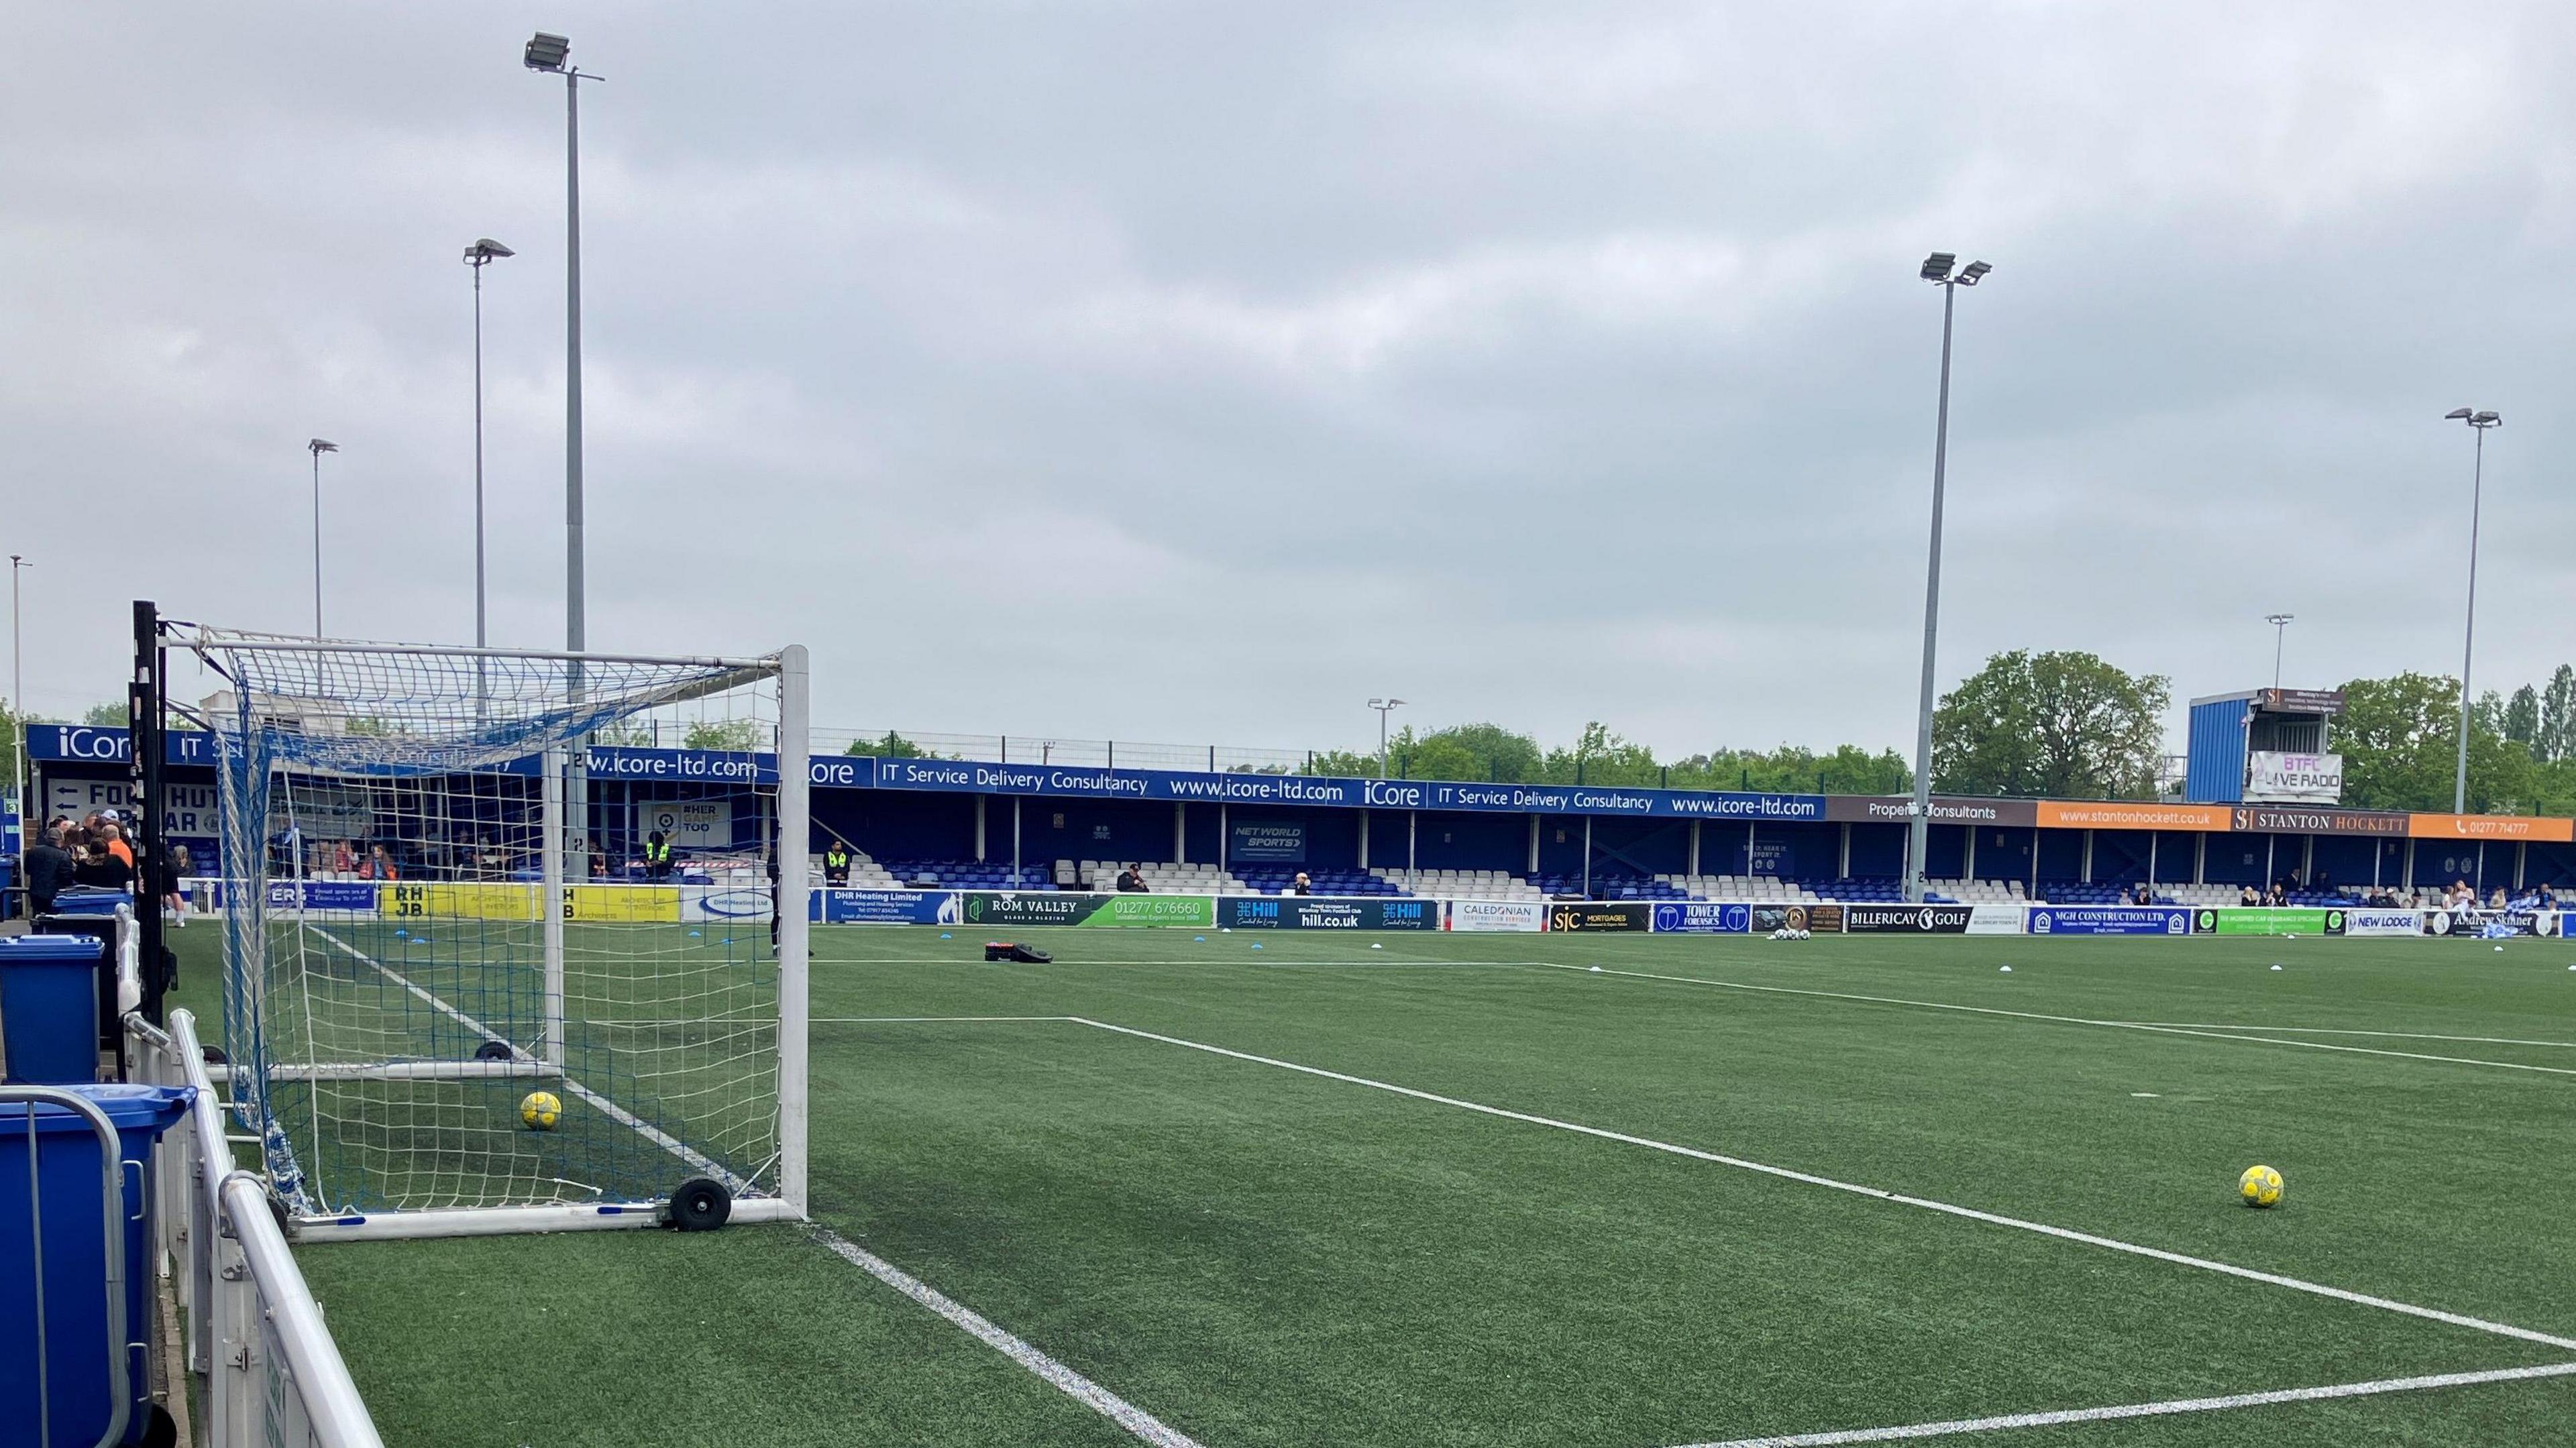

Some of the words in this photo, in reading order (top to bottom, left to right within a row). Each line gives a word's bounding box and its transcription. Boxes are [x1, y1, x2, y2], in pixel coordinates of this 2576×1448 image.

[59, 726, 131, 758] iCor
[181, 738, 201, 757] IT
[574, 753, 582, 767] 2
[588, 754, 758, 777] w.icore-ltd.com
[2284, 757, 2320, 771] BTFC
[809, 763, 854, 785] ore
[2301, 774, 2340, 787] RADIO
[883, 764, 900, 781] IT
[907, 765, 968, 785] Service
[977, 769, 1044, 791] Delivery
[1051, 771, 1148, 795] Consultancy
[1170, 778, 1342, 801] www.icore-ltd.com
[90, 784, 132, 805] FO
[170, 787, 219, 809] HUT
[1364, 780, 1419, 805] iCore
[1439, 788, 1452, 803] IT
[1458, 789, 1507, 805] Service
[1513, 790, 1568, 809] Delivery
[1574, 792, 1653, 812] Consultancy
[1672, 796, 1815, 816] www.icore-ltd.com
[683, 805, 716, 815] #HER
[1869, 803, 1910, 819] Proper
[1929, 805, 1996, 820] onsultants
[1923, 806, 1929, 817] 2
[164, 812, 197, 832] AR
[2059, 810, 2210, 825] www.stantonhockett.co.uk
[2258, 813, 2330, 829] STANTON
[2336, 816, 2406, 832] HOCKETT
[684, 824, 710, 832] TOO
[1236, 826, 1260, 836] NET
[1261, 827, 1301, 837] WORLD
[2469, 822, 2496, 833] 01277
[2499, 823, 2529, 834] 714777
[1248, 837, 1294, 847] SPORTS
[1919, 871, 1925, 883] 2
[395, 887, 423, 901] RH
[835, 891, 855, 899] DHR
[856, 892, 889, 902] Heating
[890, 892, 922, 901] Limited
[395, 903, 423, 917] JB
[992, 900, 1023, 911] ROM
[1027, 901, 1077, 913] VALLEY
[1115, 901, 1151, 914] 01277
[1155, 902, 1201, 914] 676660
[1252, 902, 1278, 917] Hill
[1397, 903, 1421, 918] Hill
[1464, 905, 1532, 916] CALEDONIAN
[1685, 905, 1721, 917] TOWER
[1301, 914, 1359, 927] hill.co.uk
[1587, 914, 1627, 923] MORTGAGES
[1684, 917, 1719, 926] FORENSICS
[1850, 912, 1917, 925] BILLERICAY
[1935, 913, 1966, 925] GOLF
[2055, 911, 2076, 921] MGH
[2078, 911, 2146, 922] CONSTRUCTION
[2147, 913, 2166, 922] LTD.
[2358, 917, 2381, 927] NEW
[2381, 917, 2413, 927] LODGE
